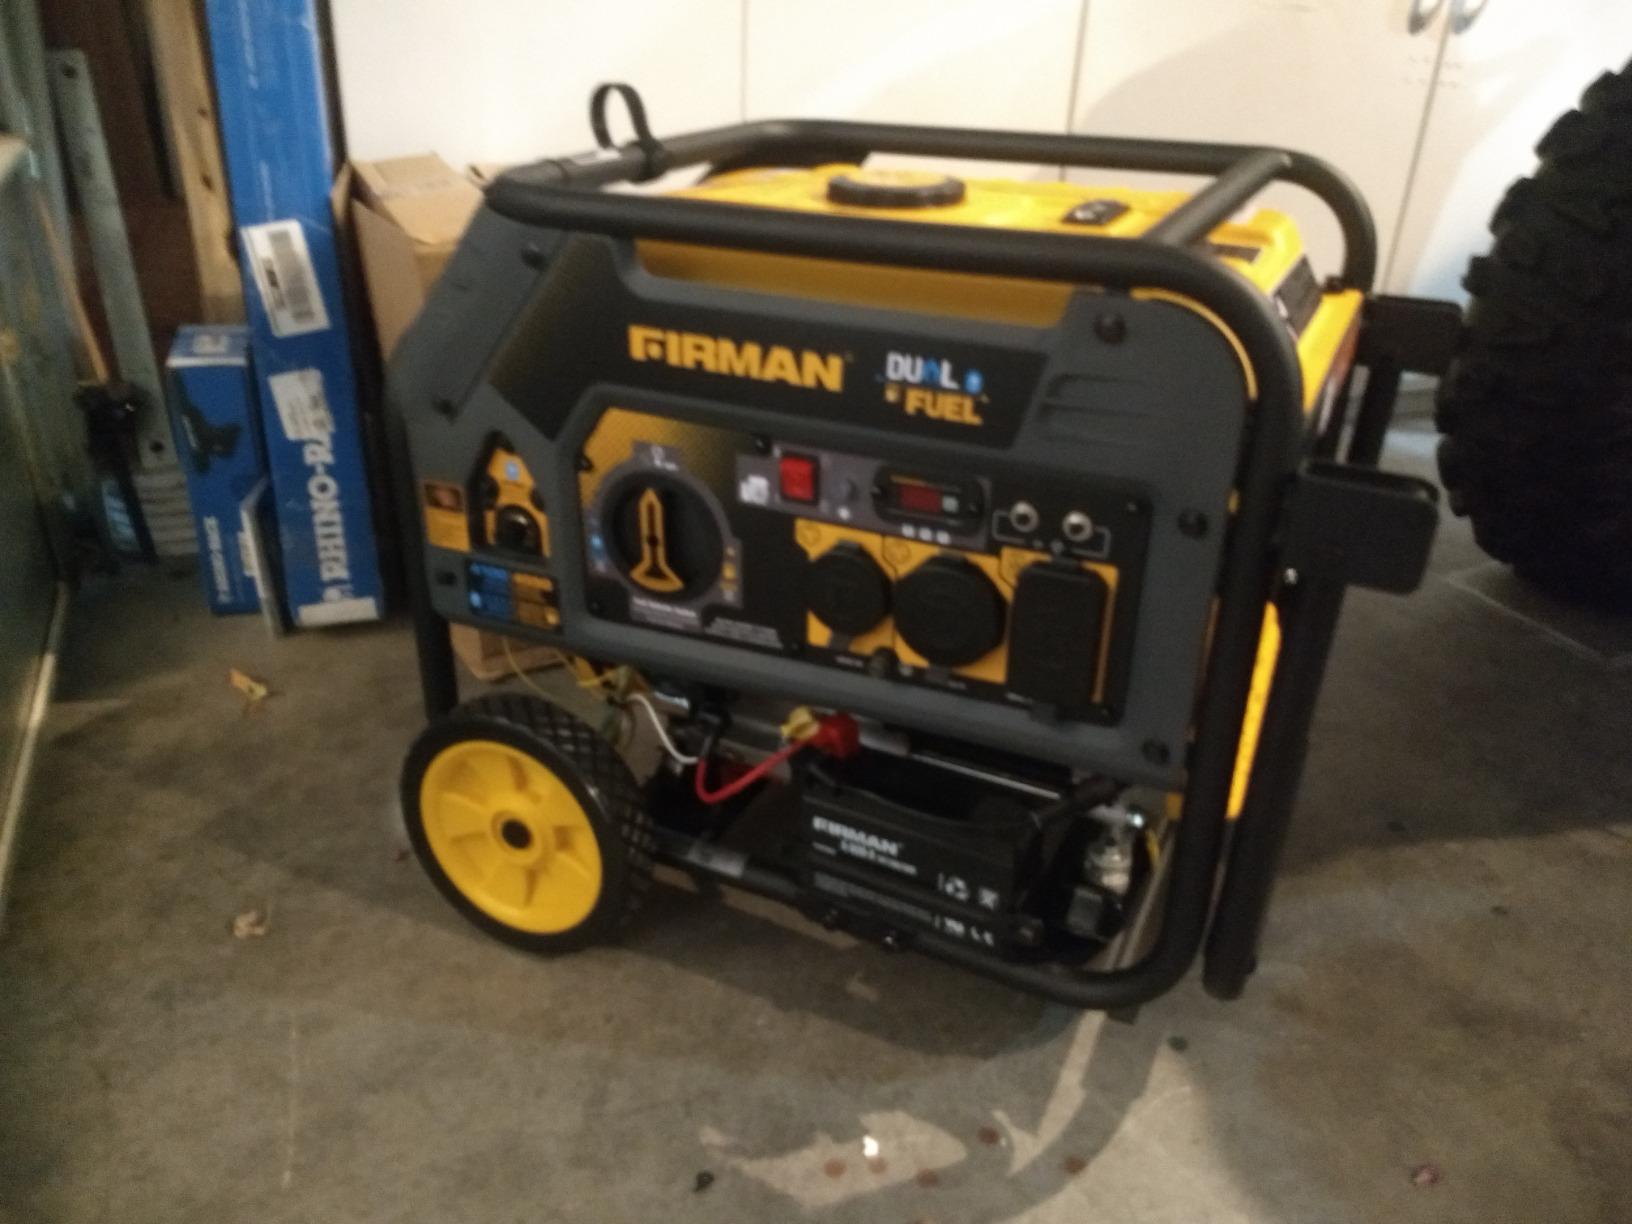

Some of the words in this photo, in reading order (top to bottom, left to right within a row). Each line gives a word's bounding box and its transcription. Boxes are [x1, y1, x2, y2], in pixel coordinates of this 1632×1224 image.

[627, 325, 844, 393] FIRMAN
[886, 350, 960, 390] DUAL
[905, 387, 983, 427] FUEL
